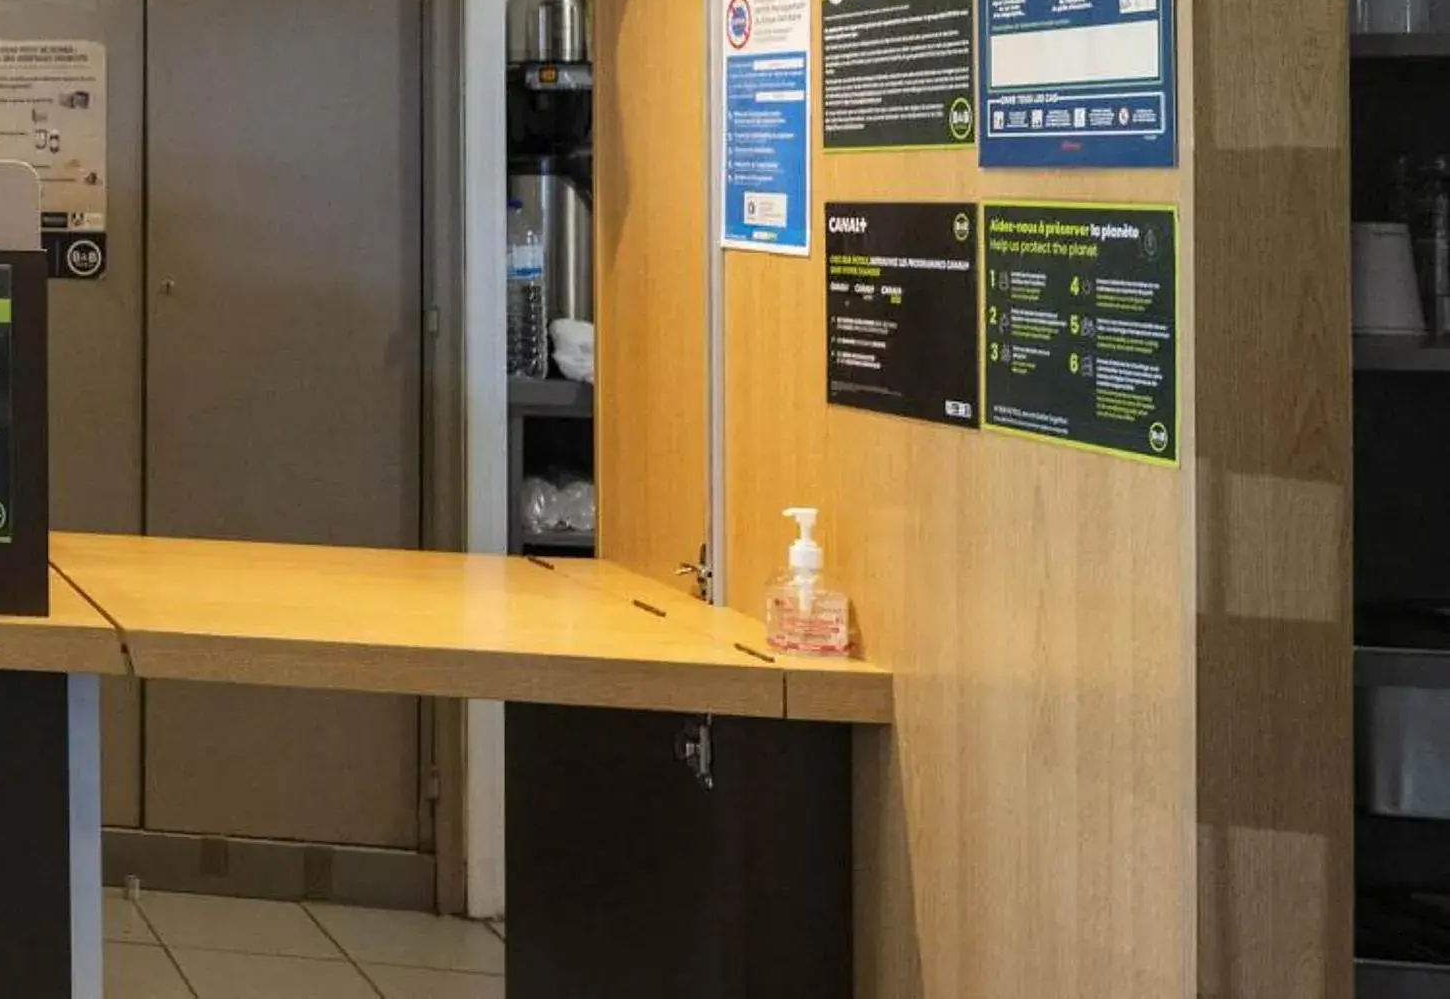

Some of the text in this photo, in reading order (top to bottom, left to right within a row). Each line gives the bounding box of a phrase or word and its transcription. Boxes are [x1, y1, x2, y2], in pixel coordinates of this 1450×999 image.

[829, 217, 867, 233] CANAL+
[1046, 221, 1089, 237] préserver
[1102, 224, 1139, 240] planète
[1020, 241, 1051, 255] protect
[1053, 242, 1067, 254] the
[989, 269, 995, 288] 1
[1070, 276, 1080, 295] 4
[989, 306, 997, 324] 2
[1070, 315, 1080, 334] 5
[990, 343, 998, 361] 3
[1069, 354, 1079, 373] 6
